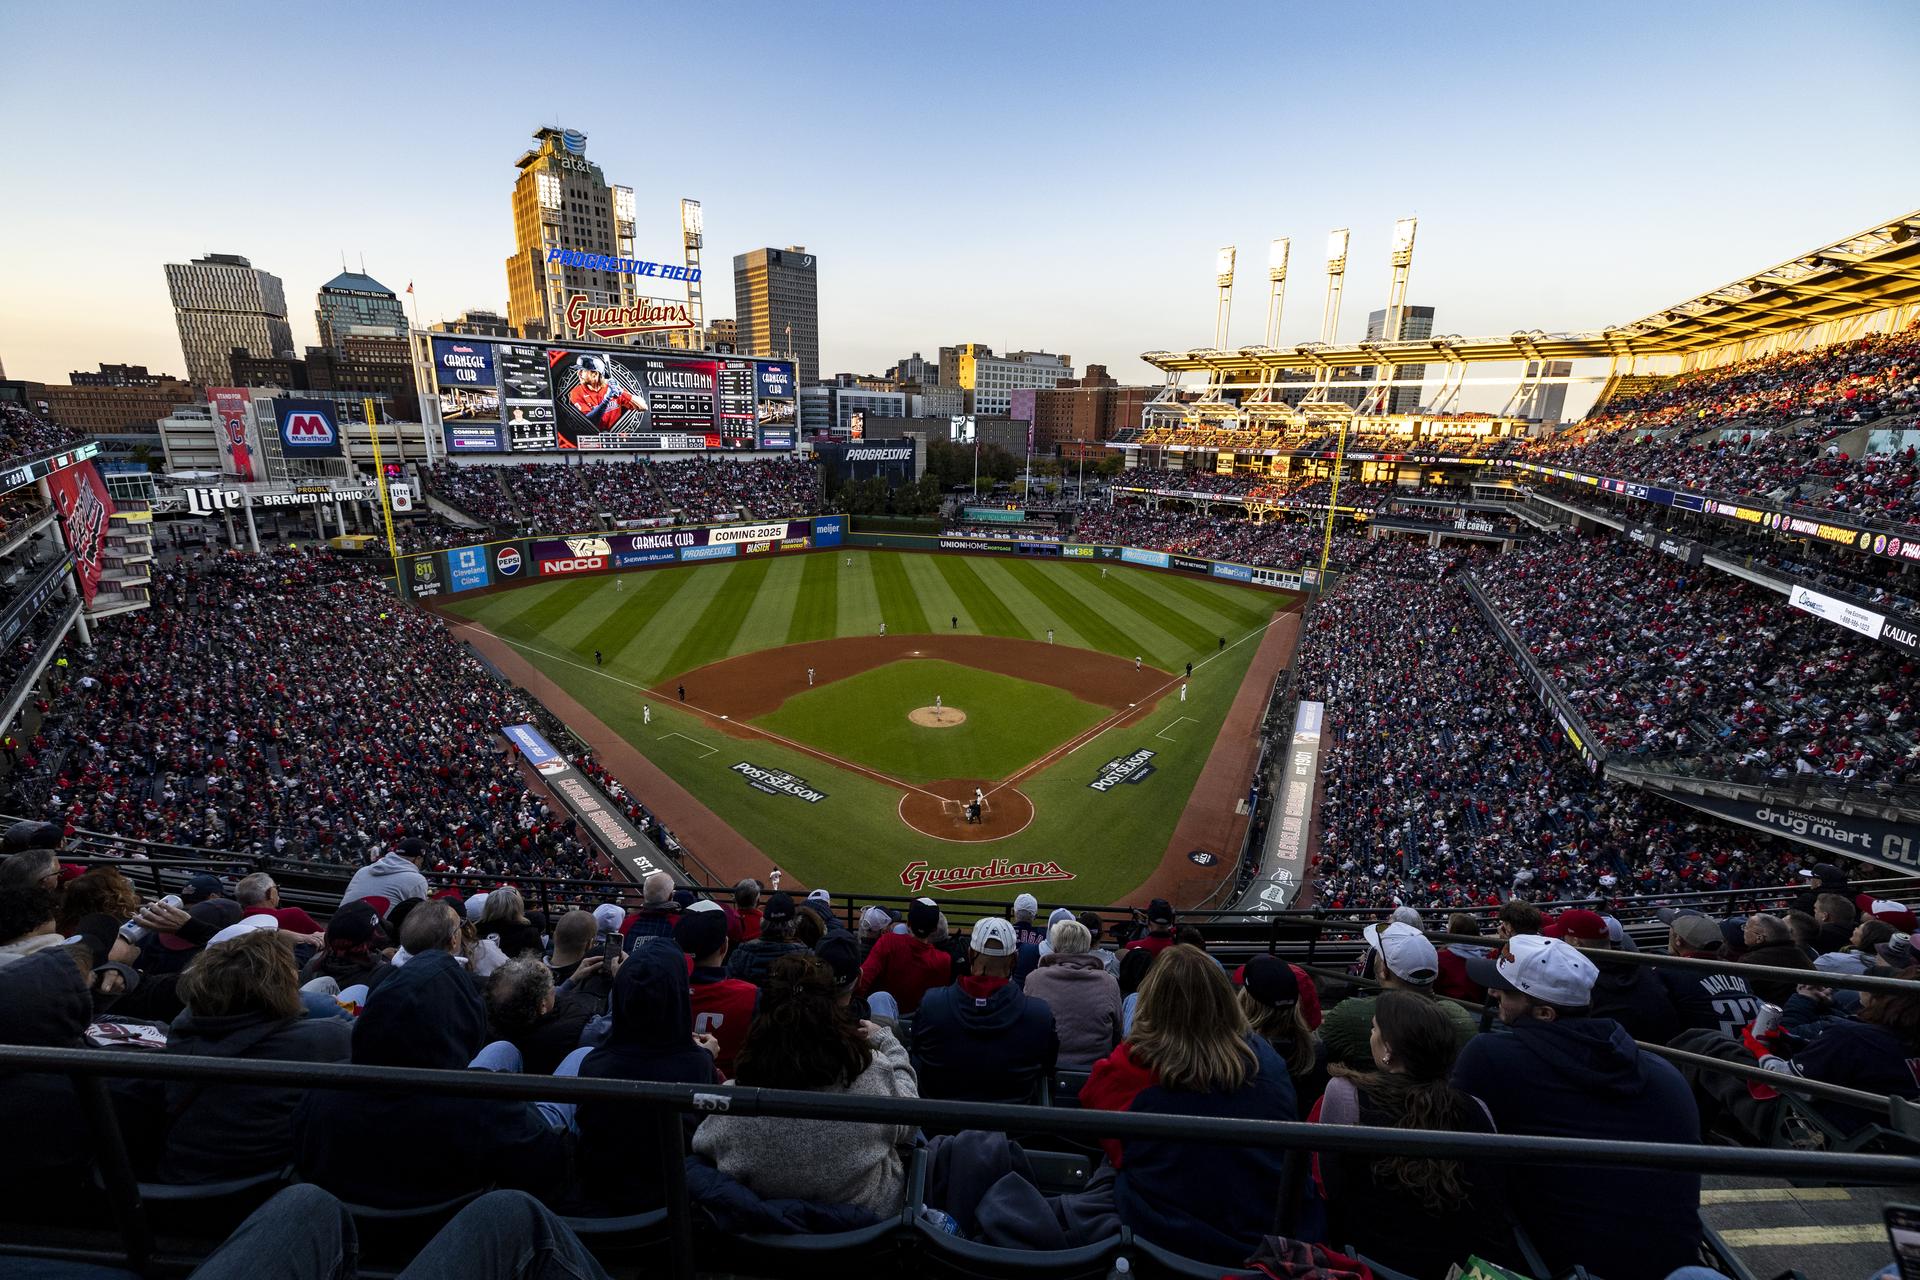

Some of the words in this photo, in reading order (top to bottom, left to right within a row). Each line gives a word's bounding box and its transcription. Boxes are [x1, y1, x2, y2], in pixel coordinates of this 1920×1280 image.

[562, 156, 592, 173] at&t
[547, 248, 659, 276] PROGRESSIVE
[660, 265, 702, 282] FIELD
[565, 294, 696, 339] Guardians
[443, 354, 485, 368] CARNEGIE
[646, 361, 665, 369] DANIEL
[456, 369, 477, 382] CLUB
[646, 371, 713, 389] SCHNEEMANN
[762, 373, 788, 384] CARNEGIE
[768, 385, 782, 395] CLUB
[846, 448, 913, 461] PROGRESSIVE
[184, 487, 241, 517] Lite
[263, 494, 318, 506] BREWED
[319, 493, 333, 503] IN
[335, 491, 363, 502] OHIO
[1717, 503, 1736, 516] PHANTOM
[1735, 507, 1764, 523] FIREWORKS
[816, 523, 840, 535] meijer
[1454, 520, 1466, 529] THE
[1467, 522, 1494, 533] CORNER
[1789, 519, 1819, 536] PHANTOM
[1816, 524, 1858, 545] FIREWORKS
[632, 534, 673, 550] CARNEGIE
[675, 532, 694, 547] CLUB
[715, 530, 756, 542] COMING
[757, 528, 782, 538] 2025
[682, 546, 734, 559] PROGRESSIVE
[746, 542, 770, 554] BLASTER
[1063, 547, 1094, 556] bet365
[1900, 542, 1920, 560] PHA
[498, 557, 520, 566] PEPSI
[1122, 551, 1166, 564] PROGRESSIVE
[416, 563, 433, 576] 811
[453, 567, 485, 577] Cleveland
[544, 558, 602, 573] NOCO
[461, 576, 480, 585] Clinic
[1270, 580, 1295, 589] CLIFFS
[1882, 624, 1918, 647] KAULIG
[1091, 749, 1155, 791] POSTSEASON
[732, 762, 824, 802] POSTSEASON
[558, 778, 600, 812] CLEVELAND
[588, 809, 637, 850] GUARDIANS
[1788, 809, 1838, 827] DISCOUNT
[1277, 816, 1302, 861] CLEVELAND
[1755, 807, 1807, 835] drug
[1811, 823, 1872, 849] mart
[1881, 833, 1920, 868] CL
[632, 855, 654, 872] EST.
[899, 858, 1077, 893] Guardians
[1699, 973, 1752, 996] NAYLOR
